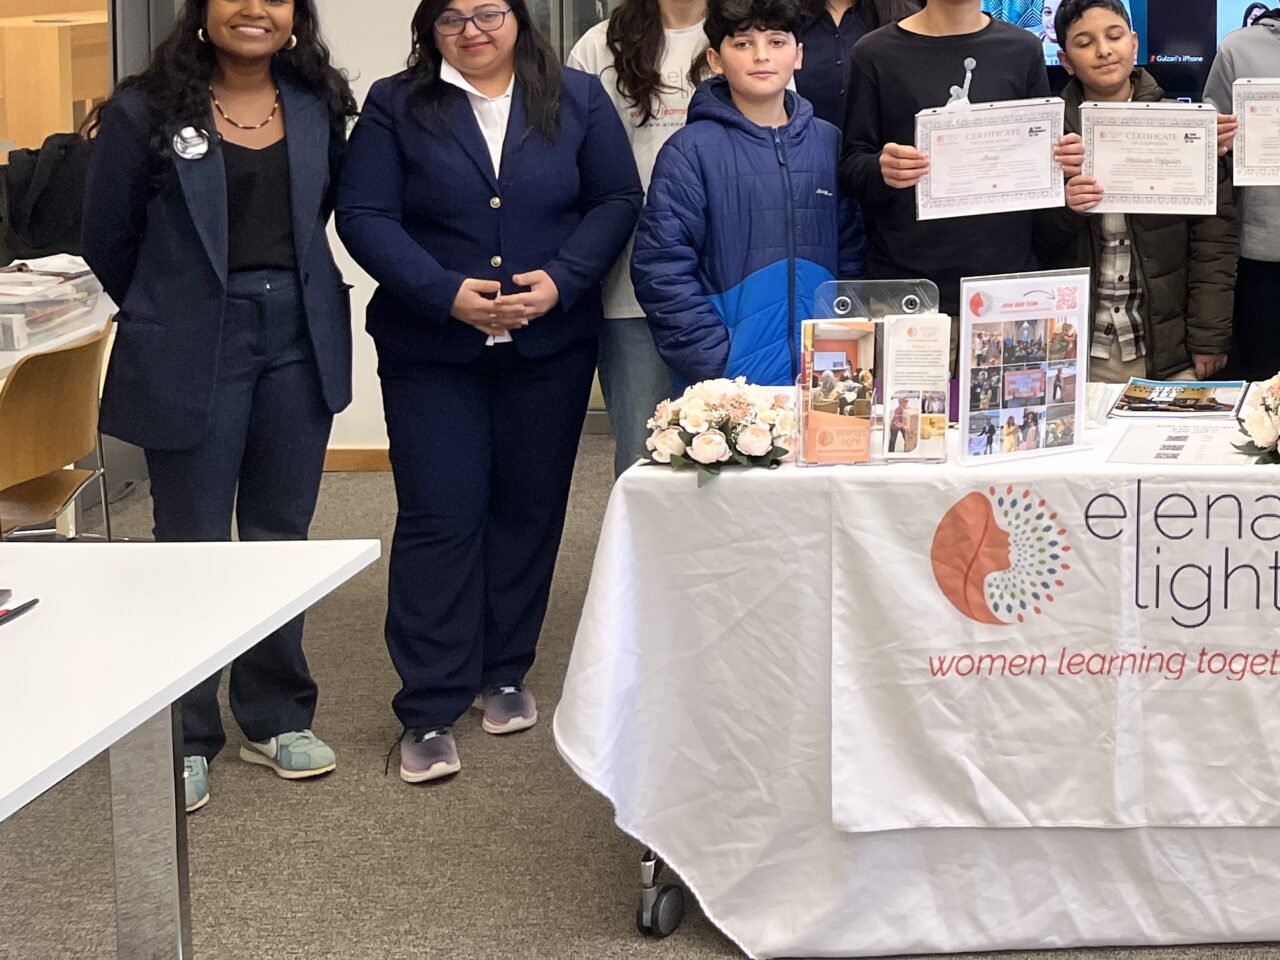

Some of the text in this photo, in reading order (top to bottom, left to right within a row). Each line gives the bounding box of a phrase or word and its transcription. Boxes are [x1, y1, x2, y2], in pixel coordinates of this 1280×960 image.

[1182, 54, 1203, 62] iPhone
[965, 128, 1021, 140] CERTIFICATE
[1125, 132, 1177, 141] CERTIFICATE
[929, 653, 1047, 677] women
[1057, 647, 1187, 680] learning
